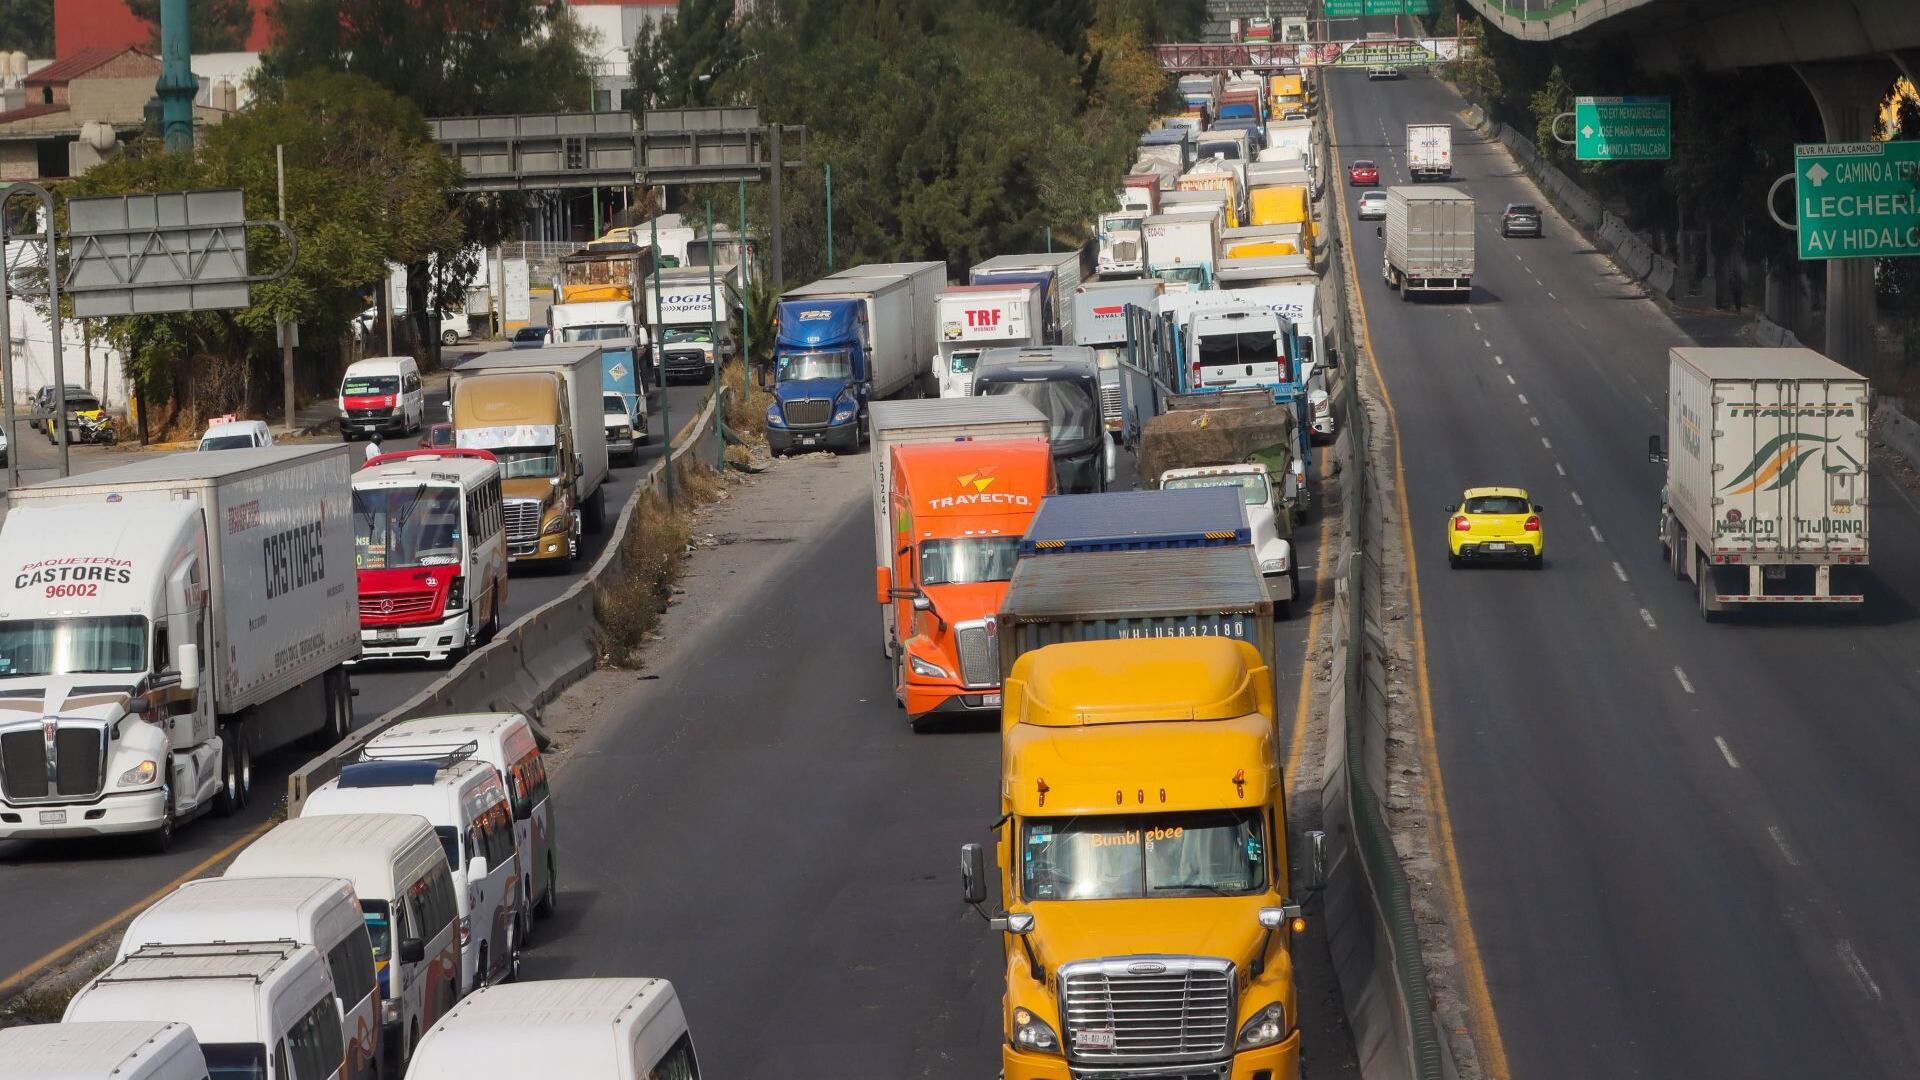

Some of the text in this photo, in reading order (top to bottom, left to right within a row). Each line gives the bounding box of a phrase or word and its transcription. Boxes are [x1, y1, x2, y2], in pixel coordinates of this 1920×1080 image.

[1635, 125, 1665, 137] MORELOS
[1598, 144, 1623, 155] CAMINO
[1624, 144, 1629, 154] A
[1847, 144, 1880, 153] CAMACHO
[1835, 161, 1881, 184] CAMINO
[1884, 161, 1893, 182] A
[1805, 187, 1920, 218] LECHERÍ
[1807, 230, 1837, 251] AV
[657, 294, 712, 304] LOGIS
[965, 309, 1001, 327] TRF
[1727, 402, 1855, 417] TRACASA
[928, 493, 1029, 510] TRAYECTO
[1832, 505, 1851, 514] 423
[1799, 519, 1862, 533] TIJUANA
[22, 557, 133, 572] PAQUETERIA
[263, 521, 325, 600] CASTORES
[15, 566, 132, 589] CASTORES
[45, 583, 98, 599] 96002
